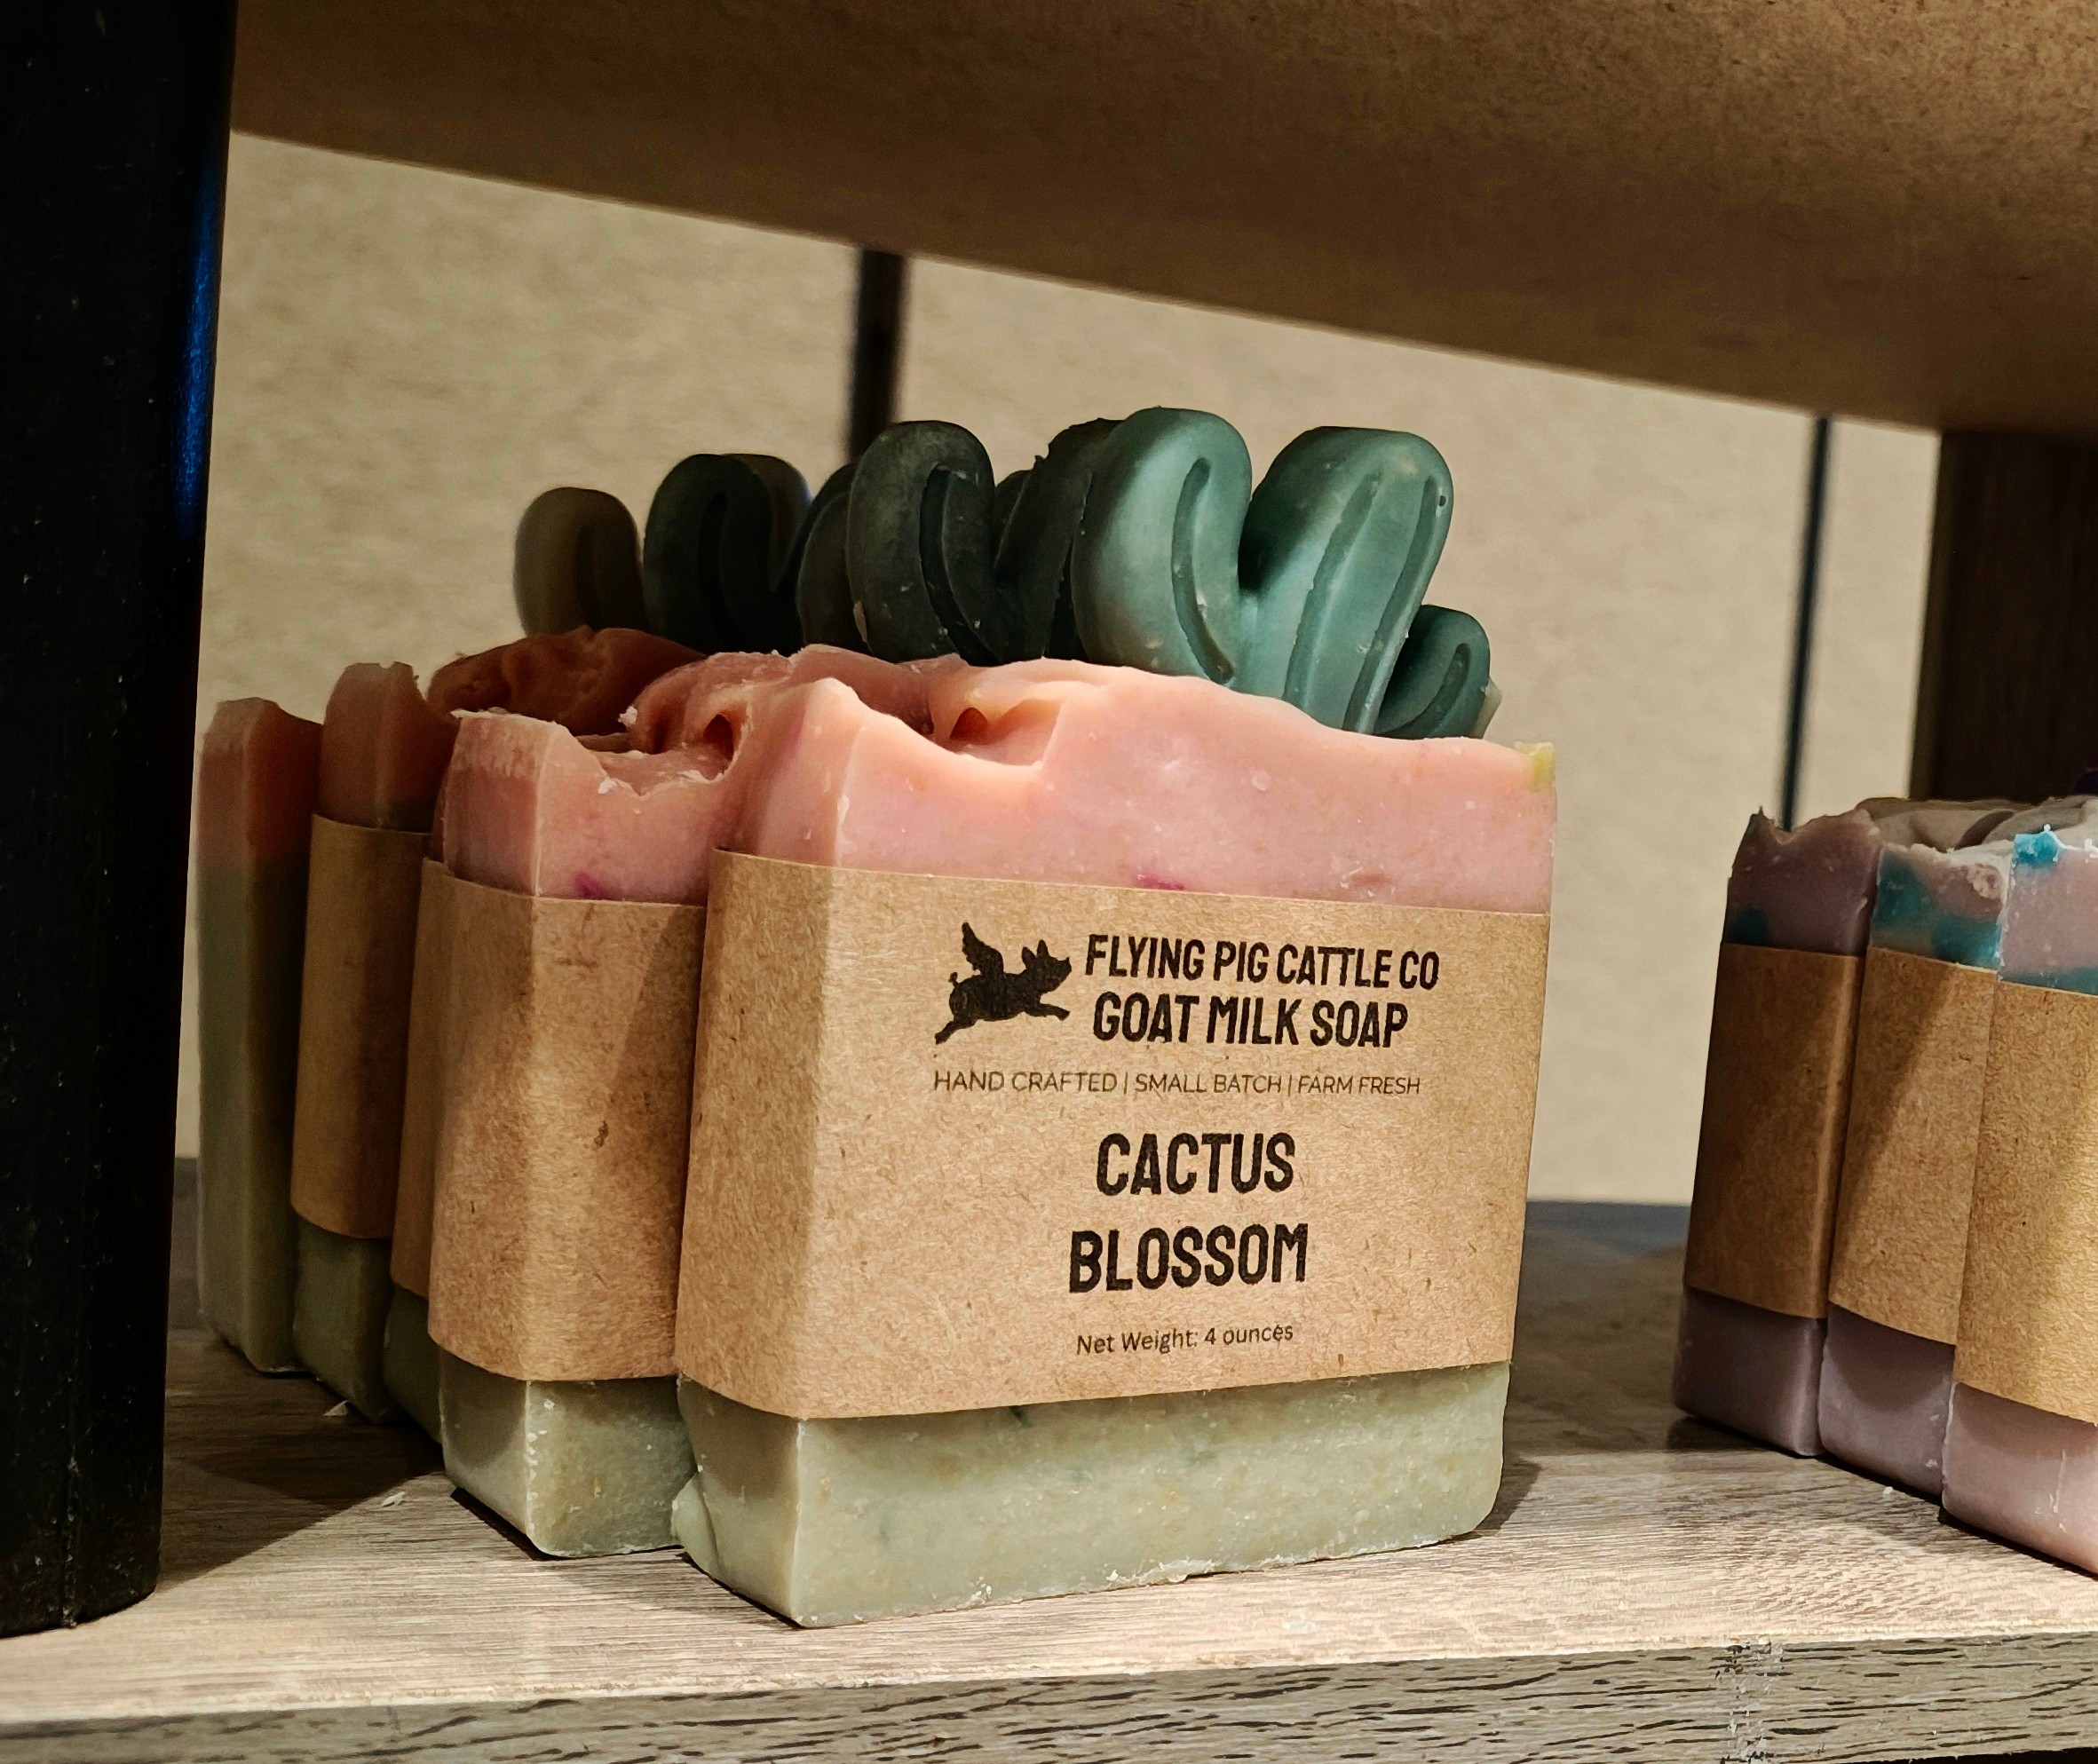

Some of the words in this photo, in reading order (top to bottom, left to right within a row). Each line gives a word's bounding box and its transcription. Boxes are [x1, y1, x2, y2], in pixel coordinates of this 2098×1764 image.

[1084, 933, 1206, 982] FLYING
[1212, 939, 1271, 984] PIG
[1276, 943, 1394, 989] CATTLE
[1398, 950, 1440, 992] CO
[1092, 991, 1200, 1045] GOAT
[1206, 995, 1302, 1046] MILK
[1309, 999, 1409, 1048] SOAP
[933, 1068, 1005, 1093] HAND
[1011, 1071, 1118, 1093] CRAFTED
[1134, 1072, 1207, 1094] SMALL
[1213, 1073, 1282, 1094] BATCH
[1297, 1074, 1354, 1095] FARM
[1358, 1076, 1421, 1096] FRESH
[1096, 1131, 1296, 1197] CACTUS
[1068, 1222, 1309, 1294] BLOSSOM
[1076, 1333, 1115, 1356] Net
[1120, 1327, 1199, 1355] Weight:
[1203, 1326, 1217, 1346] 4
[1223, 1324, 1294, 1346] ounces
